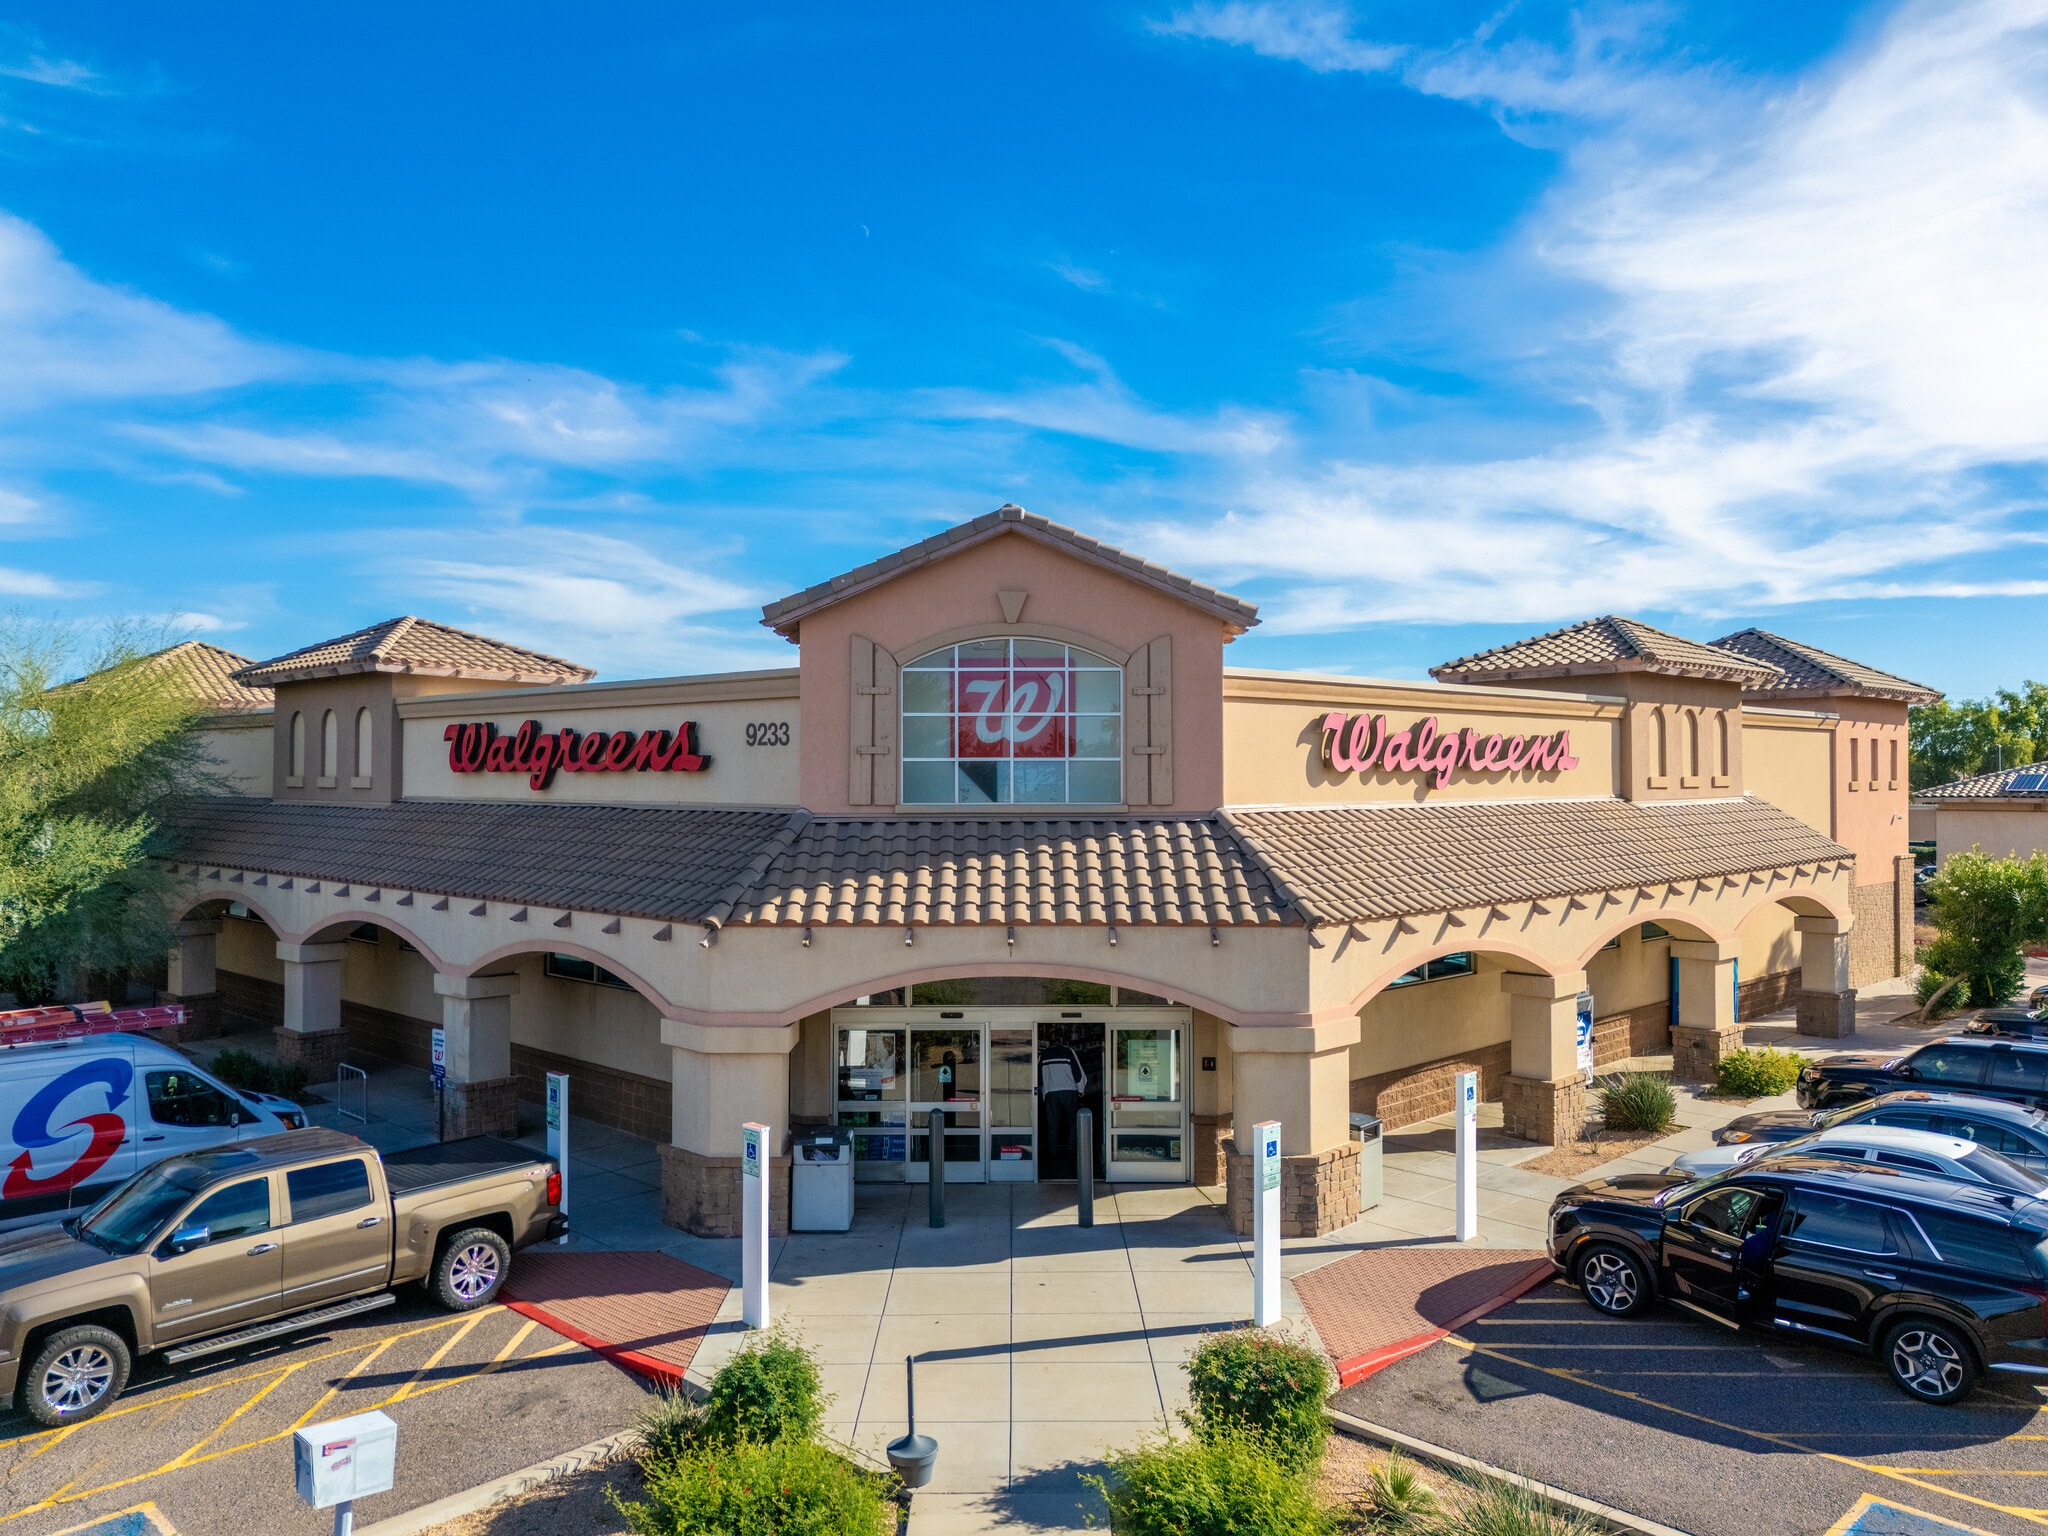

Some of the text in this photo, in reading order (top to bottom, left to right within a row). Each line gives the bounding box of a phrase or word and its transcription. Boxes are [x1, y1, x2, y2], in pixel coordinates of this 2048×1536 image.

[746, 722, 790, 747] 9233
[966, 672, 1063, 743] W
[444, 720, 711, 790] Walgreens
[1320, 712, 1579, 790] Walgreens
